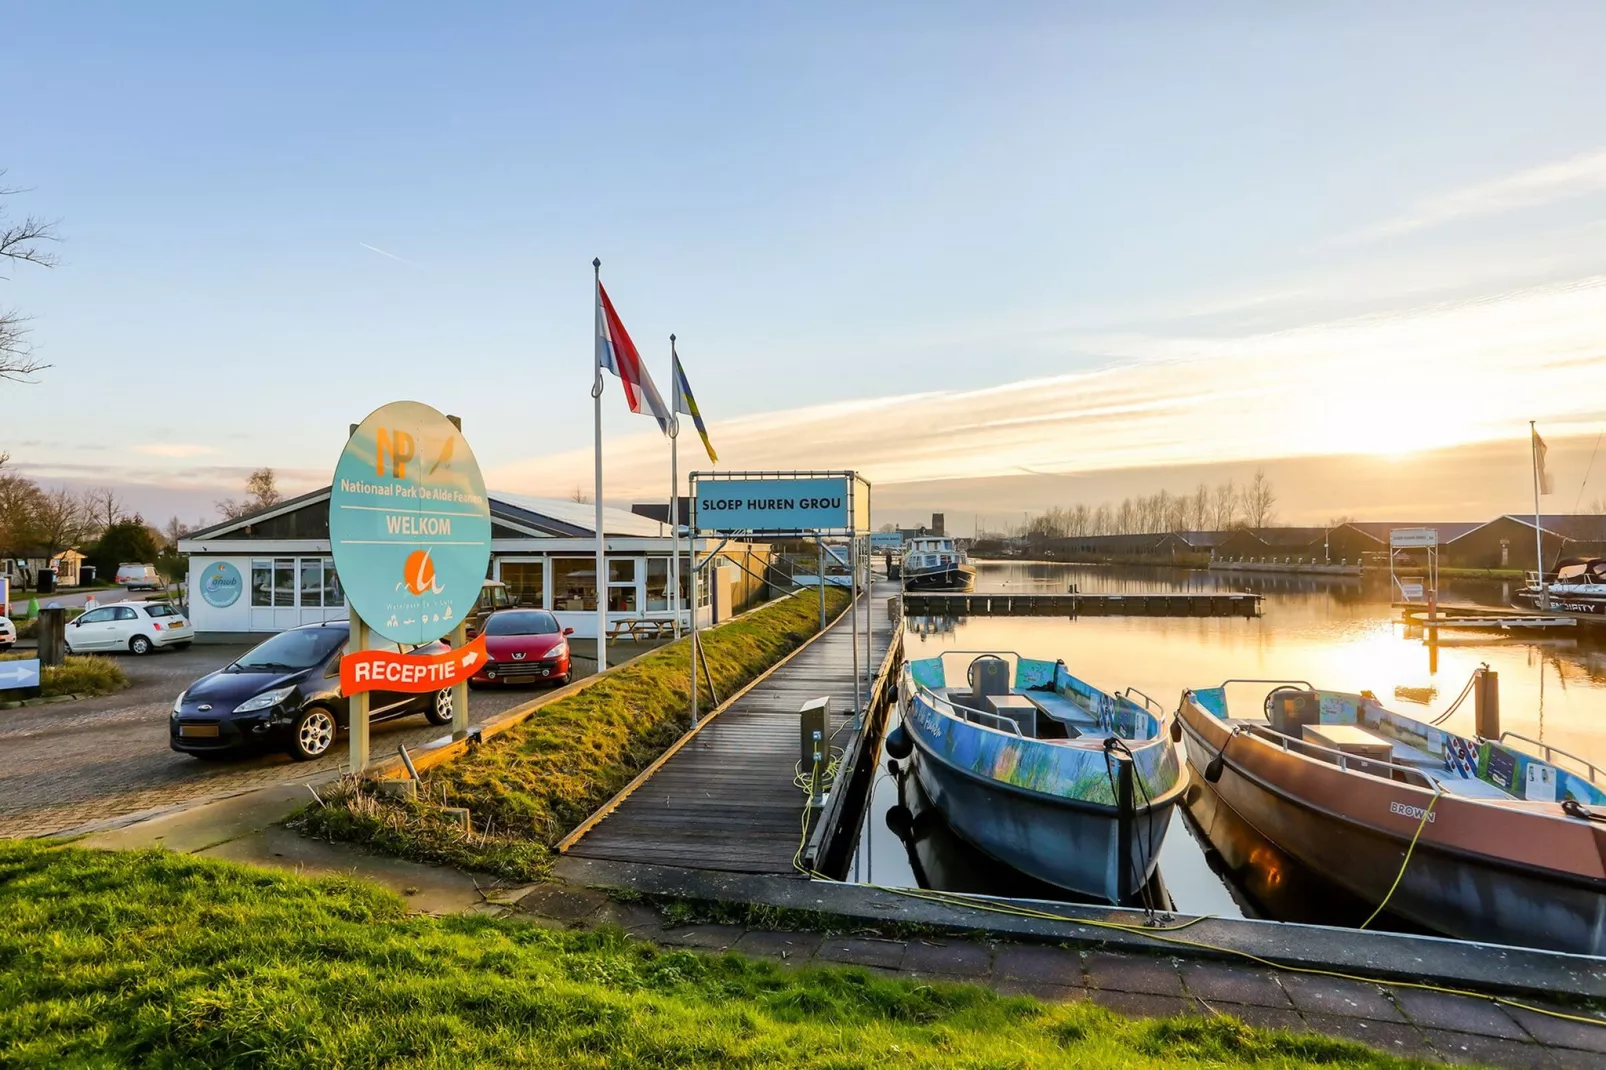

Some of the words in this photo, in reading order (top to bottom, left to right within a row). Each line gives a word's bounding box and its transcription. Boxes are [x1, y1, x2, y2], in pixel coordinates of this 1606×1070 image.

[341, 479, 393, 496] Nationaal
[395, 484, 417, 498] Park
[419, 487, 431, 499] De
[433, 488, 452, 501] Alde
[702, 499, 743, 511] SLOEP
[747, 498, 794, 510] HUREN
[799, 497, 841, 510] GROU
[386, 515, 451, 535] WELKOM
[355, 660, 456, 683] RECEPTIE
[1390, 801, 1436, 823] BROWN
